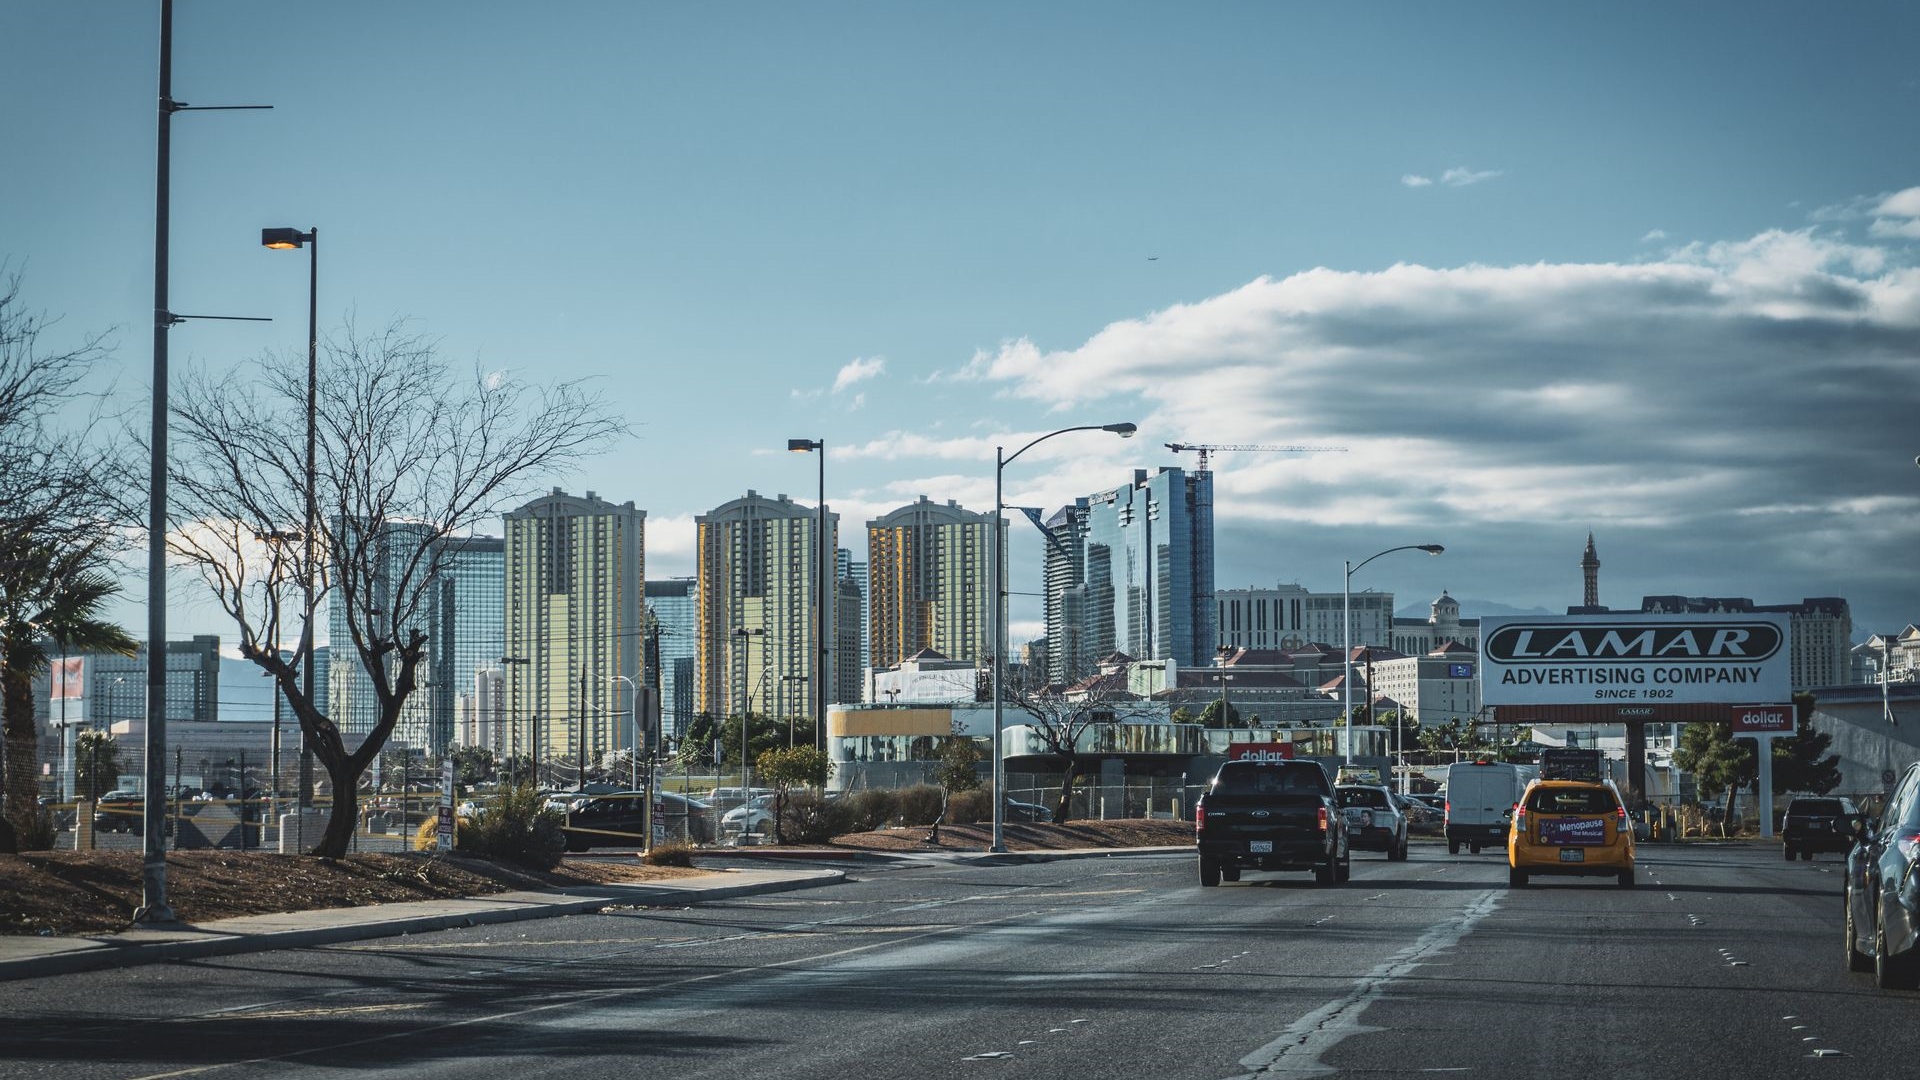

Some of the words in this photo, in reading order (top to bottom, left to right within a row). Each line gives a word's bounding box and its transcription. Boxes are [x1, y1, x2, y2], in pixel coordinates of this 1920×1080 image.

[1512, 629, 1750, 657] LAMAR
[1502, 668, 1645, 685] ADVERTISING
[1653, 666, 1762, 684] COMPANY
[1594, 689, 1636, 699] SINCE
[1642, 688, 1674, 698] 1902
[1560, 820, 1603, 831] Menopause
